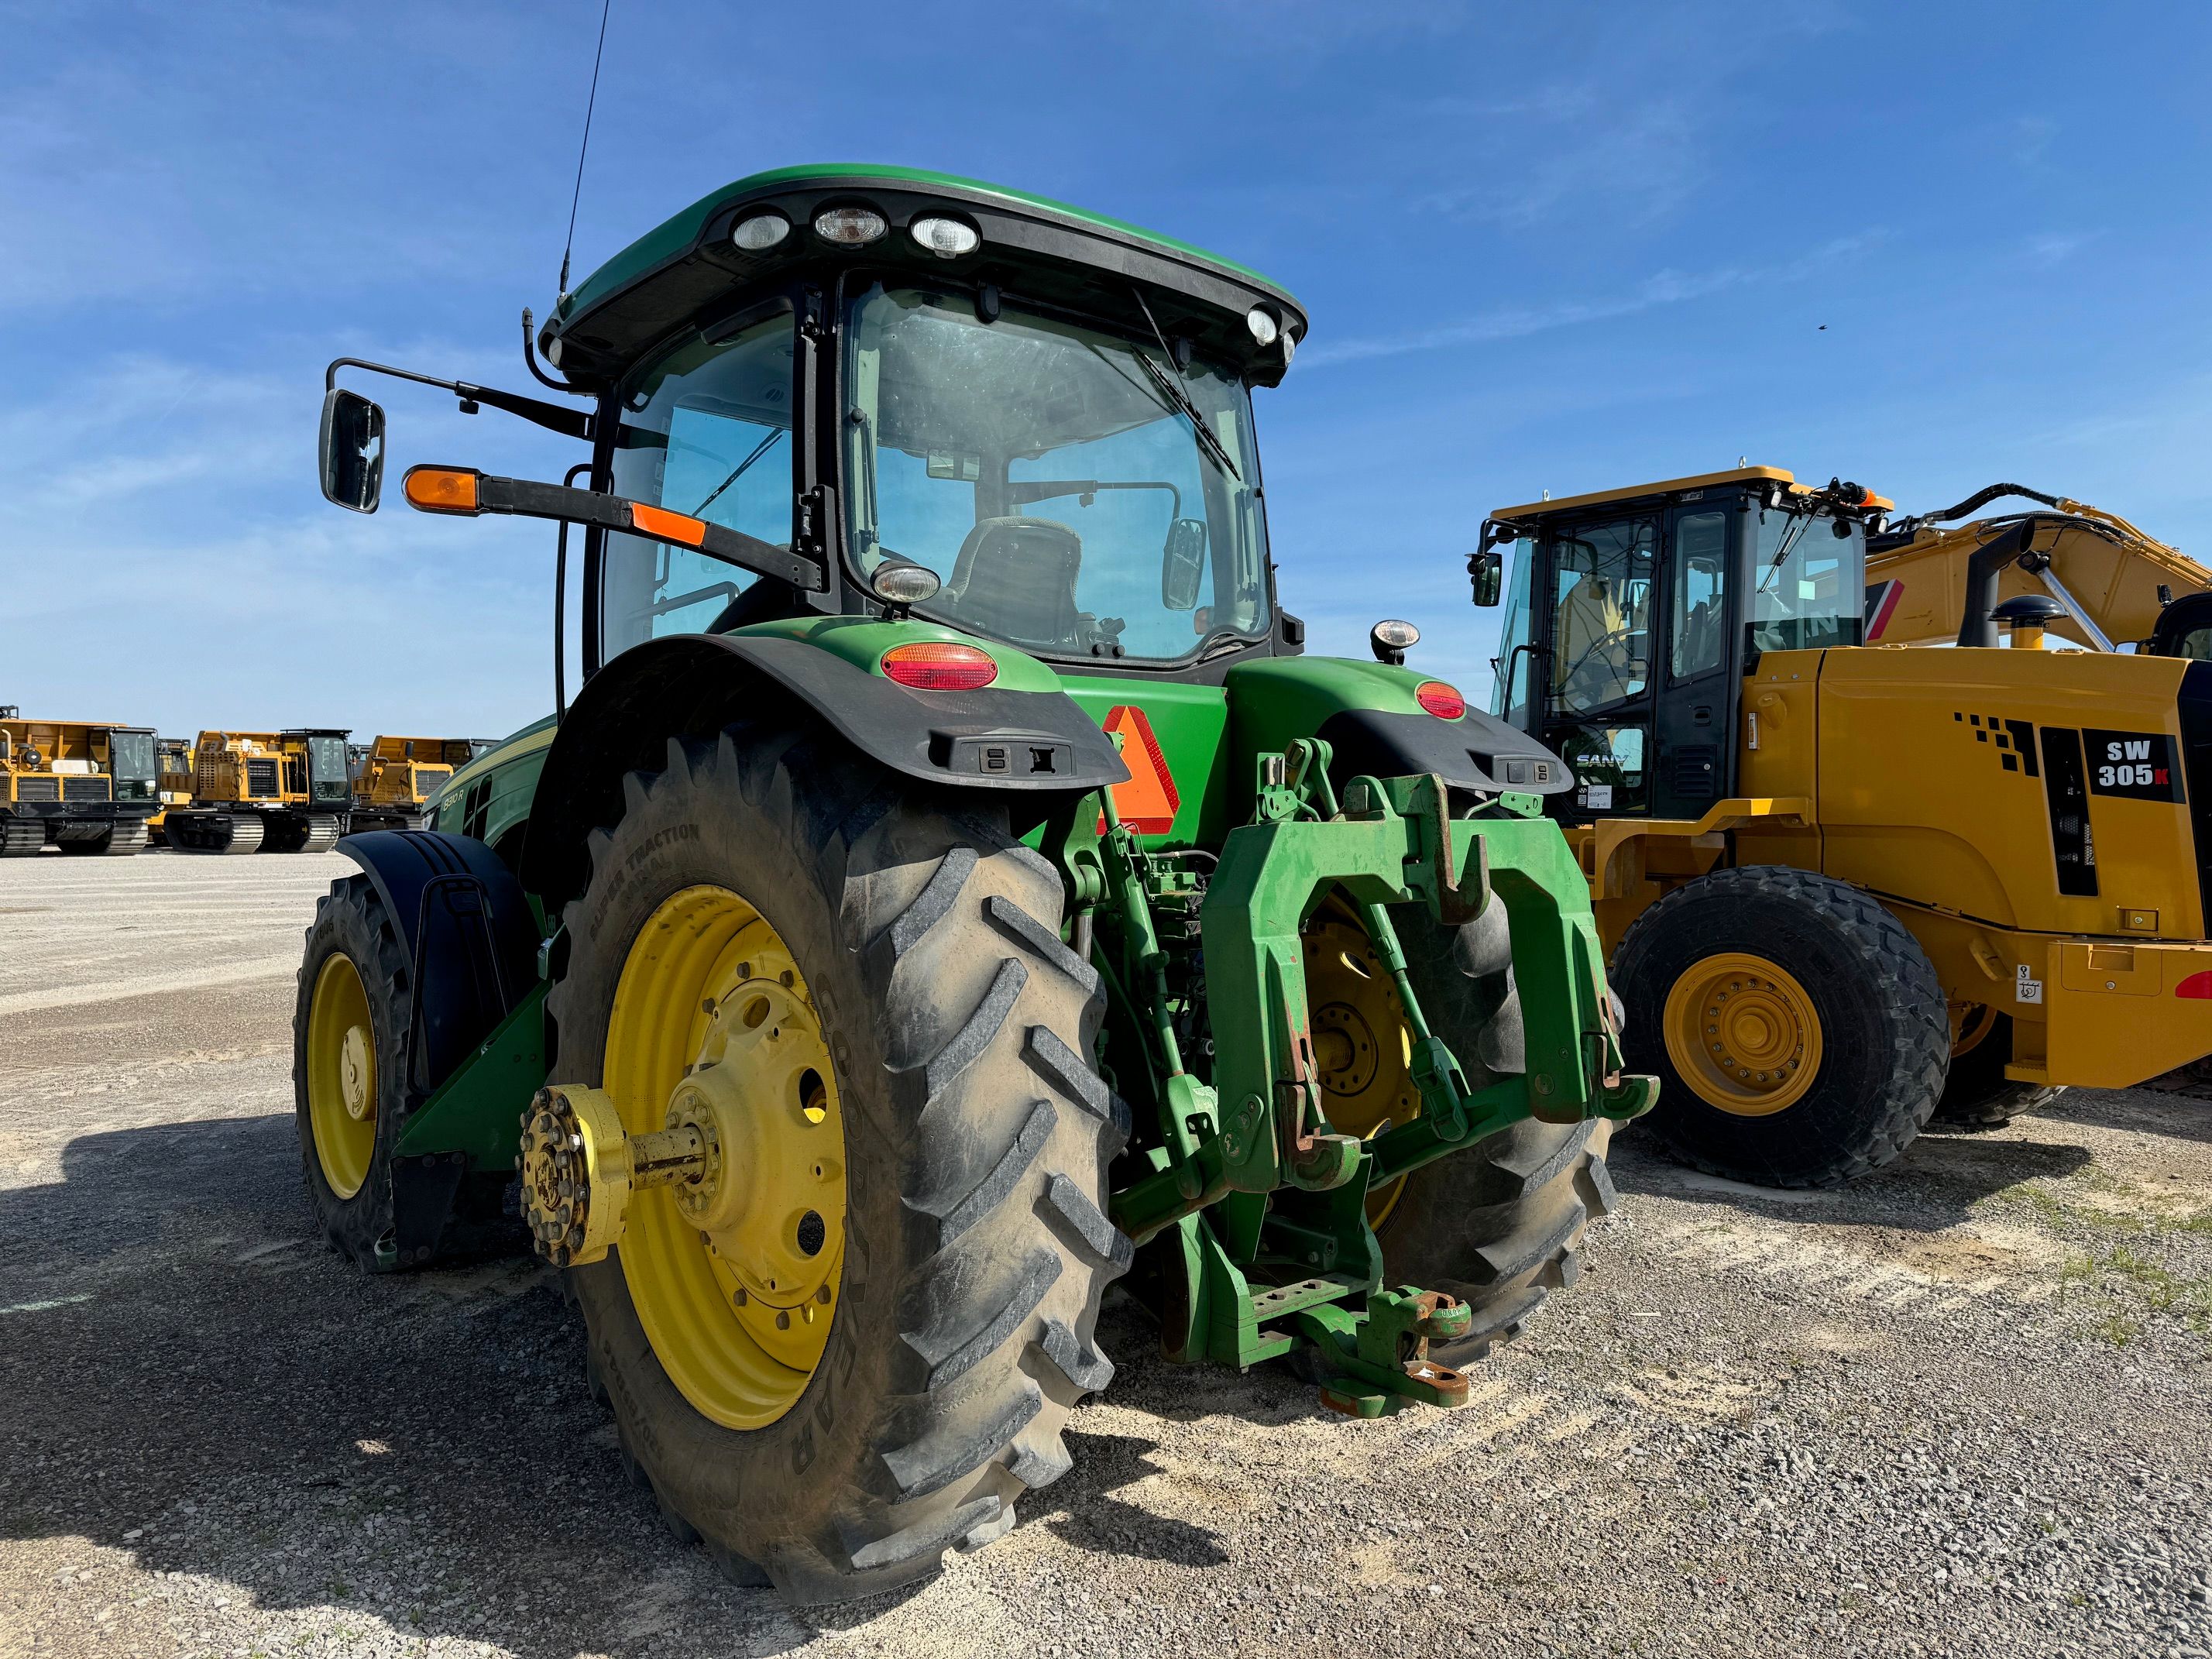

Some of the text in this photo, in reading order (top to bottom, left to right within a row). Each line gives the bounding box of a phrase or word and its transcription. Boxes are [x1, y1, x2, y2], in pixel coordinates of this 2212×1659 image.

[1576, 754, 1630, 768] SANY
[2107, 740, 2151, 761] SW
[625, 823, 701, 871] TRACTION
